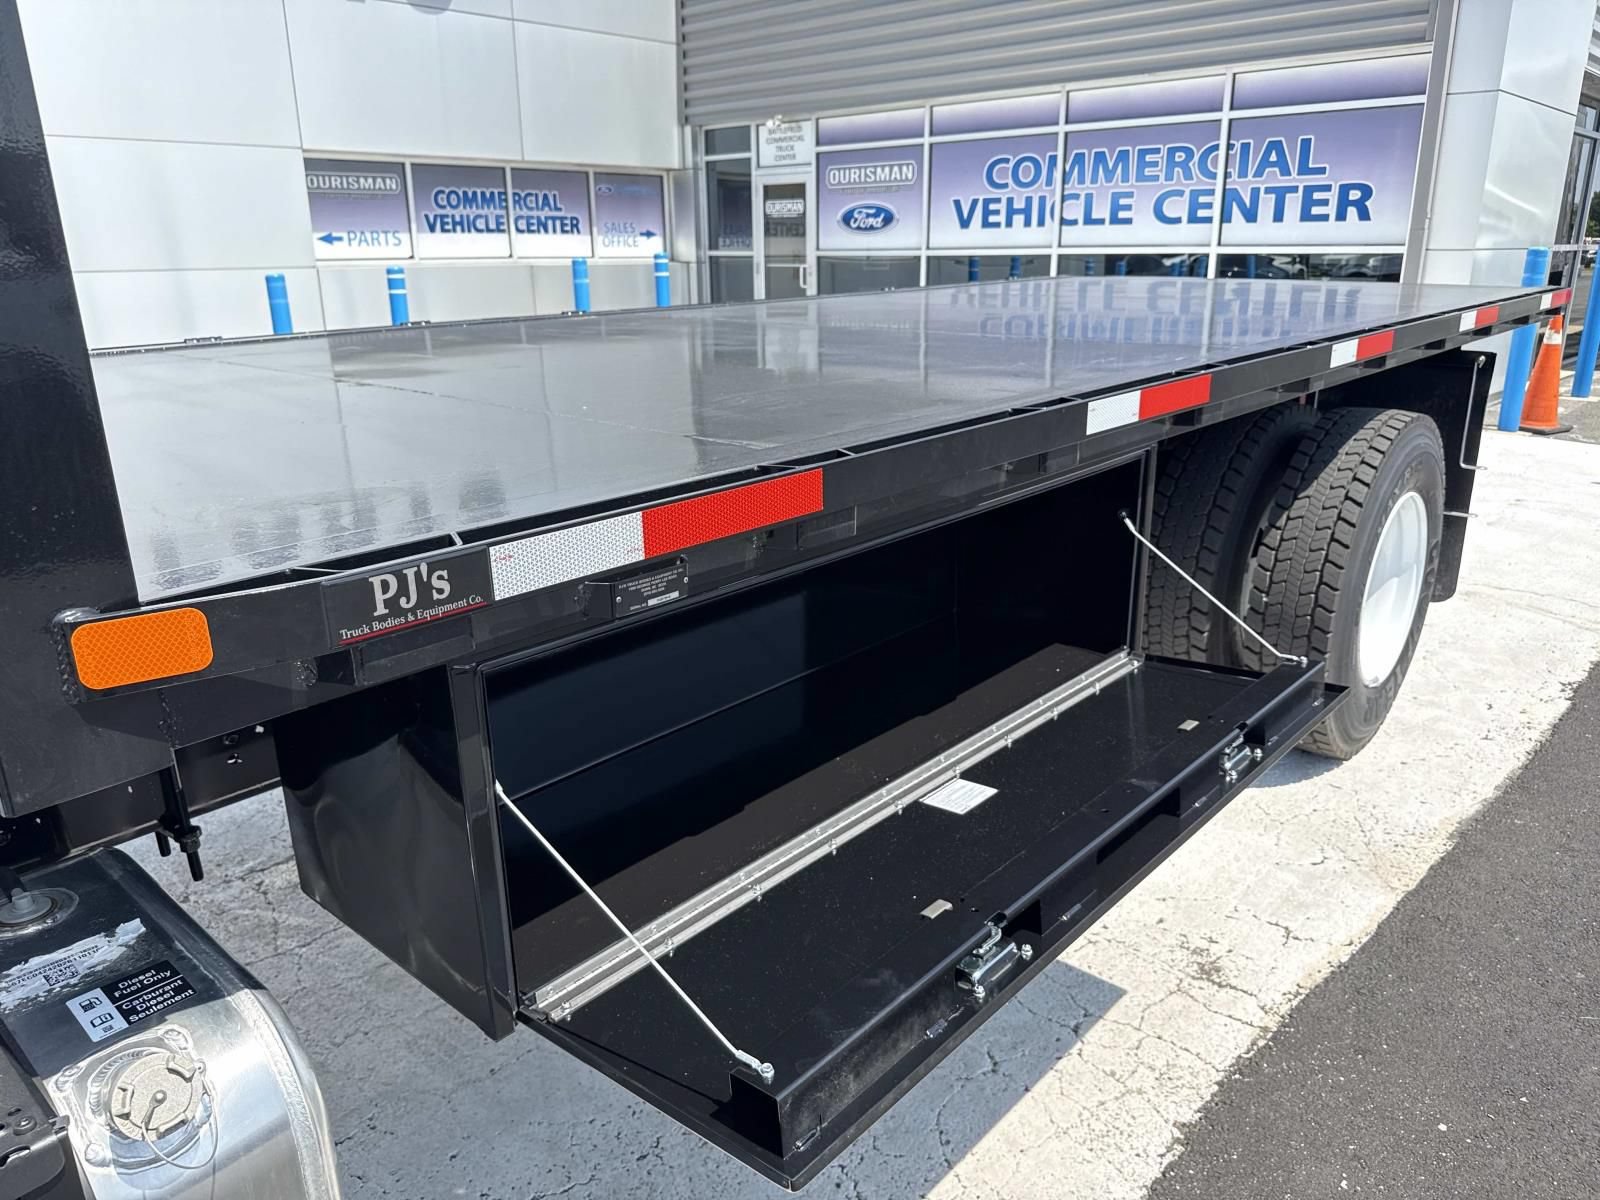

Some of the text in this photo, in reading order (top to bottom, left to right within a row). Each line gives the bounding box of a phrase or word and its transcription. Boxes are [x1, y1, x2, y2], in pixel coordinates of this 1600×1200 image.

[774, 154, 796, 162] CENTER
[775, 145, 794, 153] TRUCK
[829, 164, 913, 184] OURISMAN
[985, 137, 1328, 190] COMMERCIAL
[307, 175, 397, 190] OURISMAN
[433, 188, 562, 212] COMMERCIAL
[953, 183, 1374, 229] VEHICLE CENTER
[424, 213, 581, 234] VEHICLE CENTER
[604, 222, 637, 234] SALES
[850, 208, 885, 228] Ford
[347, 230, 402, 247] PARTS
[602, 236, 640, 248] OFFICE
[368, 562, 450, 616] PJ's
[340, 594, 484, 640] Truck Bodies & Equipment Co.
[114, 970, 171, 998] Fuel Only
[118, 970, 157, 989] Diesel
[122, 980, 184, 1010] Carburant
[128, 989, 195, 1022] Seulement
[136, 990, 174, 1012] Diesel
